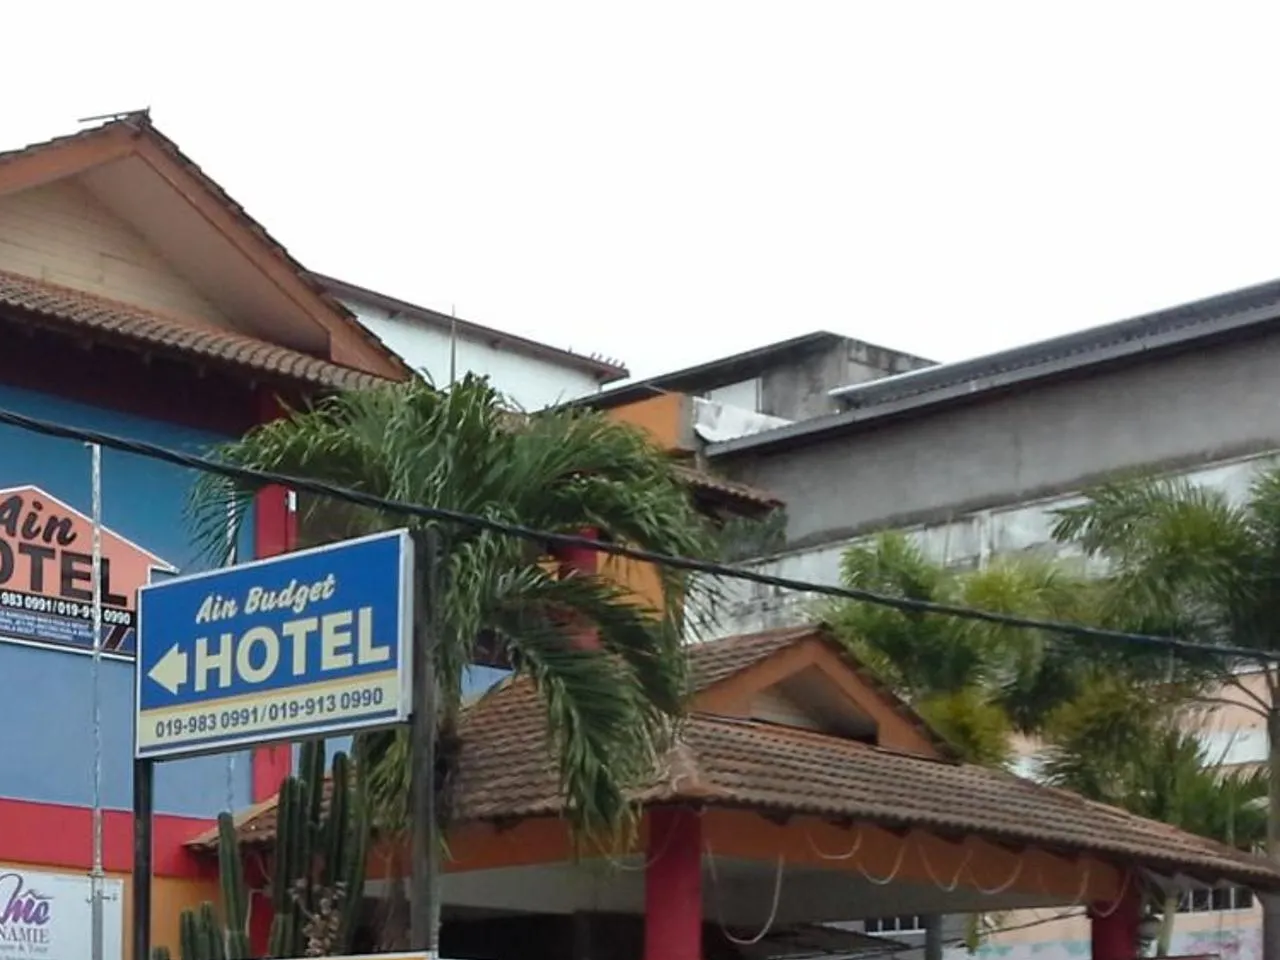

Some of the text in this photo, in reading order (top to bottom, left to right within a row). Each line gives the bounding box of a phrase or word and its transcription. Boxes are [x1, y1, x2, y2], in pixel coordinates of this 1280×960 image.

[195, 573, 336, 624] Ain Budget
[195, 607, 390, 692] HOTEL
[156, 713, 216, 738] 019-983
[340, 687, 383, 710] 0990
